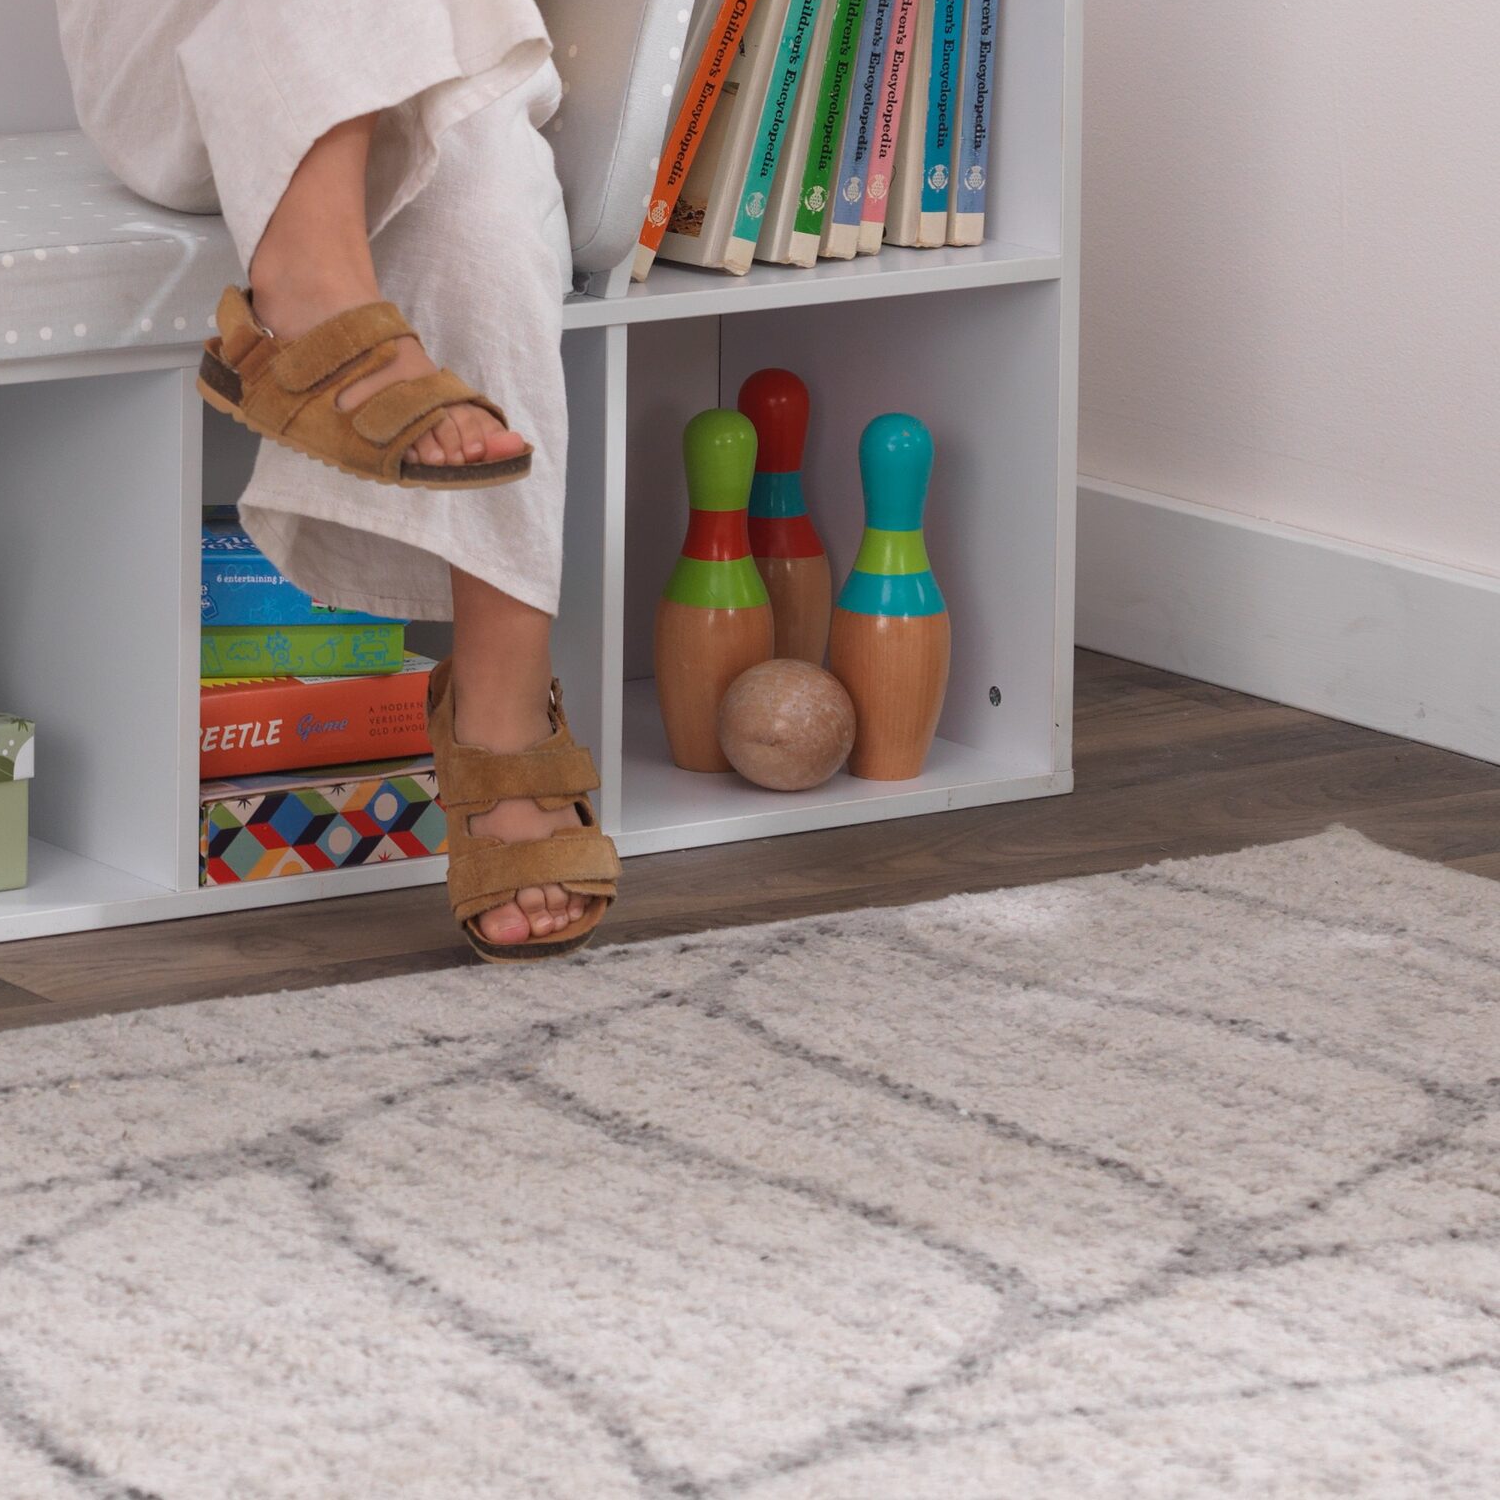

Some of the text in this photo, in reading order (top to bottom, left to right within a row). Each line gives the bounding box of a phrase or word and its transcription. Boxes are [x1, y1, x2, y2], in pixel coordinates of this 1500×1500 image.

[668, 82, 716, 186] Encyclopedia
[760, 68, 797, 178] Encyclopedia
[818, 60, 849, 171] Encyclopedia
[855, 51, 881, 162] Encyclopedia
[879, 50, 905, 159] Encyclopedia
[937, 39, 954, 149] Encyclopedia
[974, 40, 992, 151] Encyclopedia
[216, 574, 222, 583] 6
[224, 575, 277, 585] entertaining
[200, 714, 349, 752] EETLE Game
[369, 724, 425, 737] OLD FAVOU
